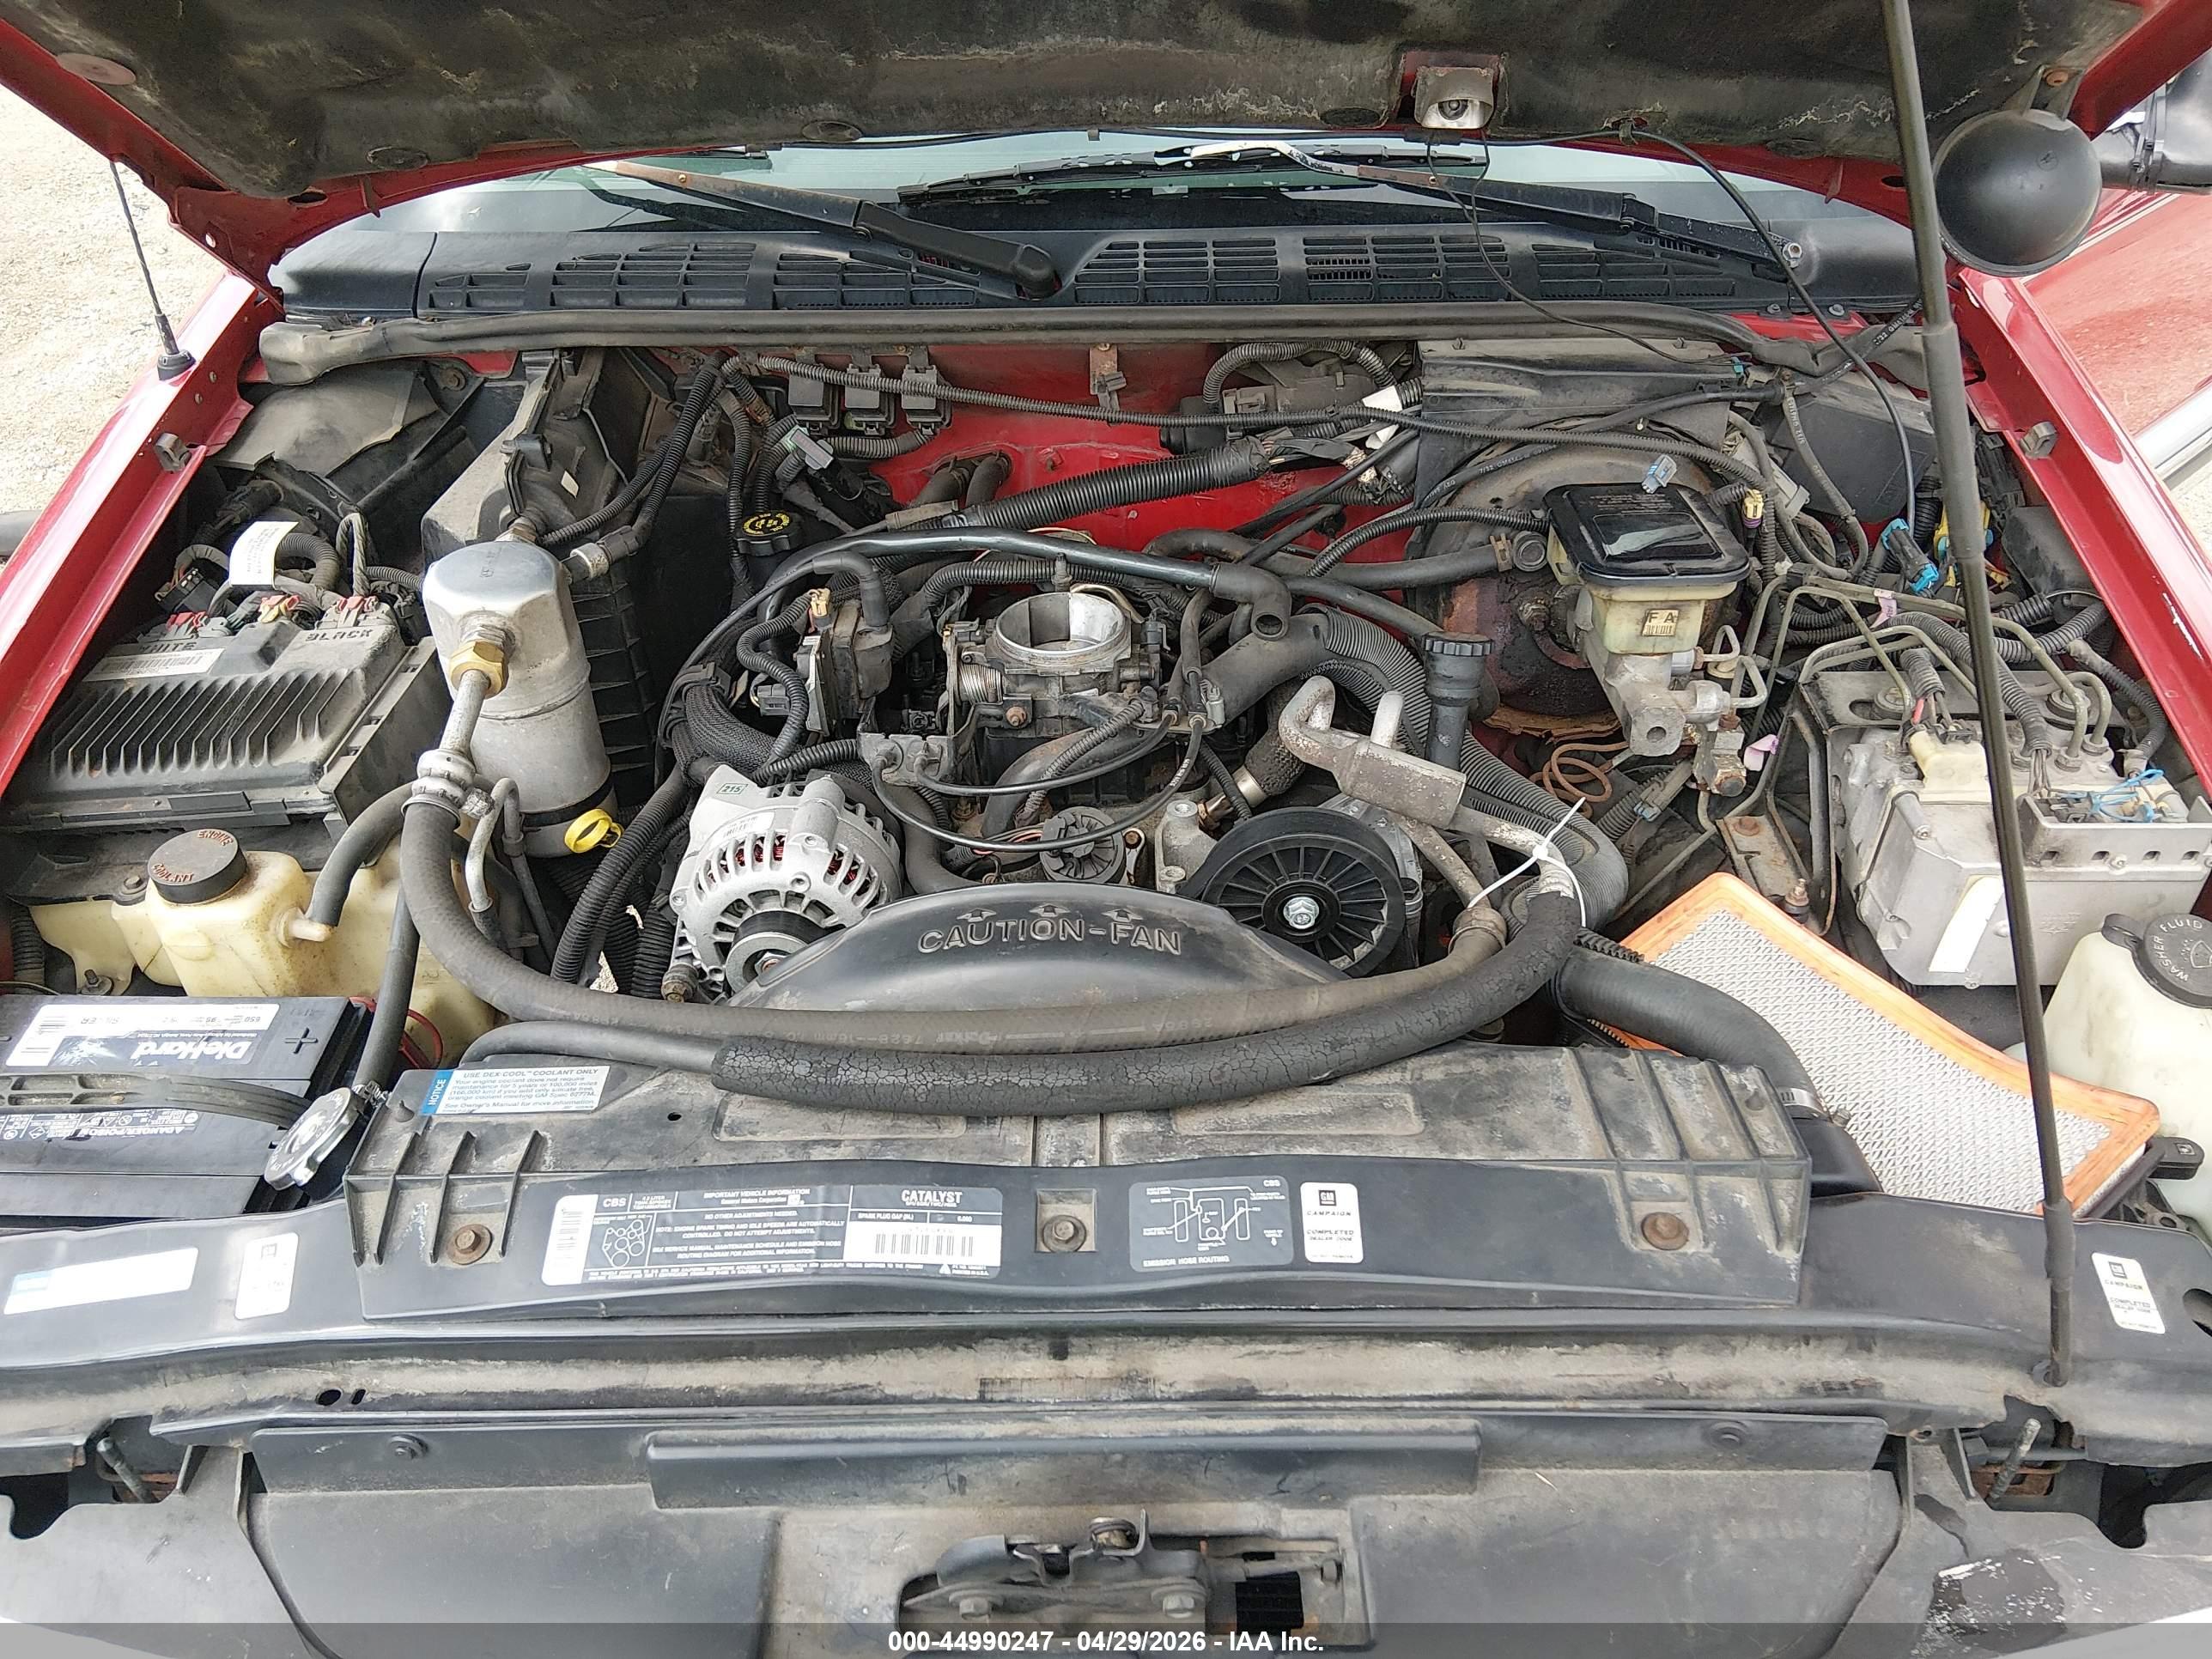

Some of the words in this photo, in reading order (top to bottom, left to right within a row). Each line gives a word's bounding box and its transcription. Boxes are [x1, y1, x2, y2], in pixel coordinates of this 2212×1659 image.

[306, 629, 373, 641] BLACK
[198, 830, 234, 847] ENGINE
[152, 862, 194, 883] COOLANT
[2160, 919, 2203, 933] FLUID
[2153, 935, 2189, 981] WASHER
[131, 1040, 253, 1060] DieHard
[428, 1079, 447, 1106] NOTICE
[603, 1198, 627, 1207] CBS
[901, 1190, 963, 1204] CATALYST
[1198, 1255, 1230, 1264] ROUTING
